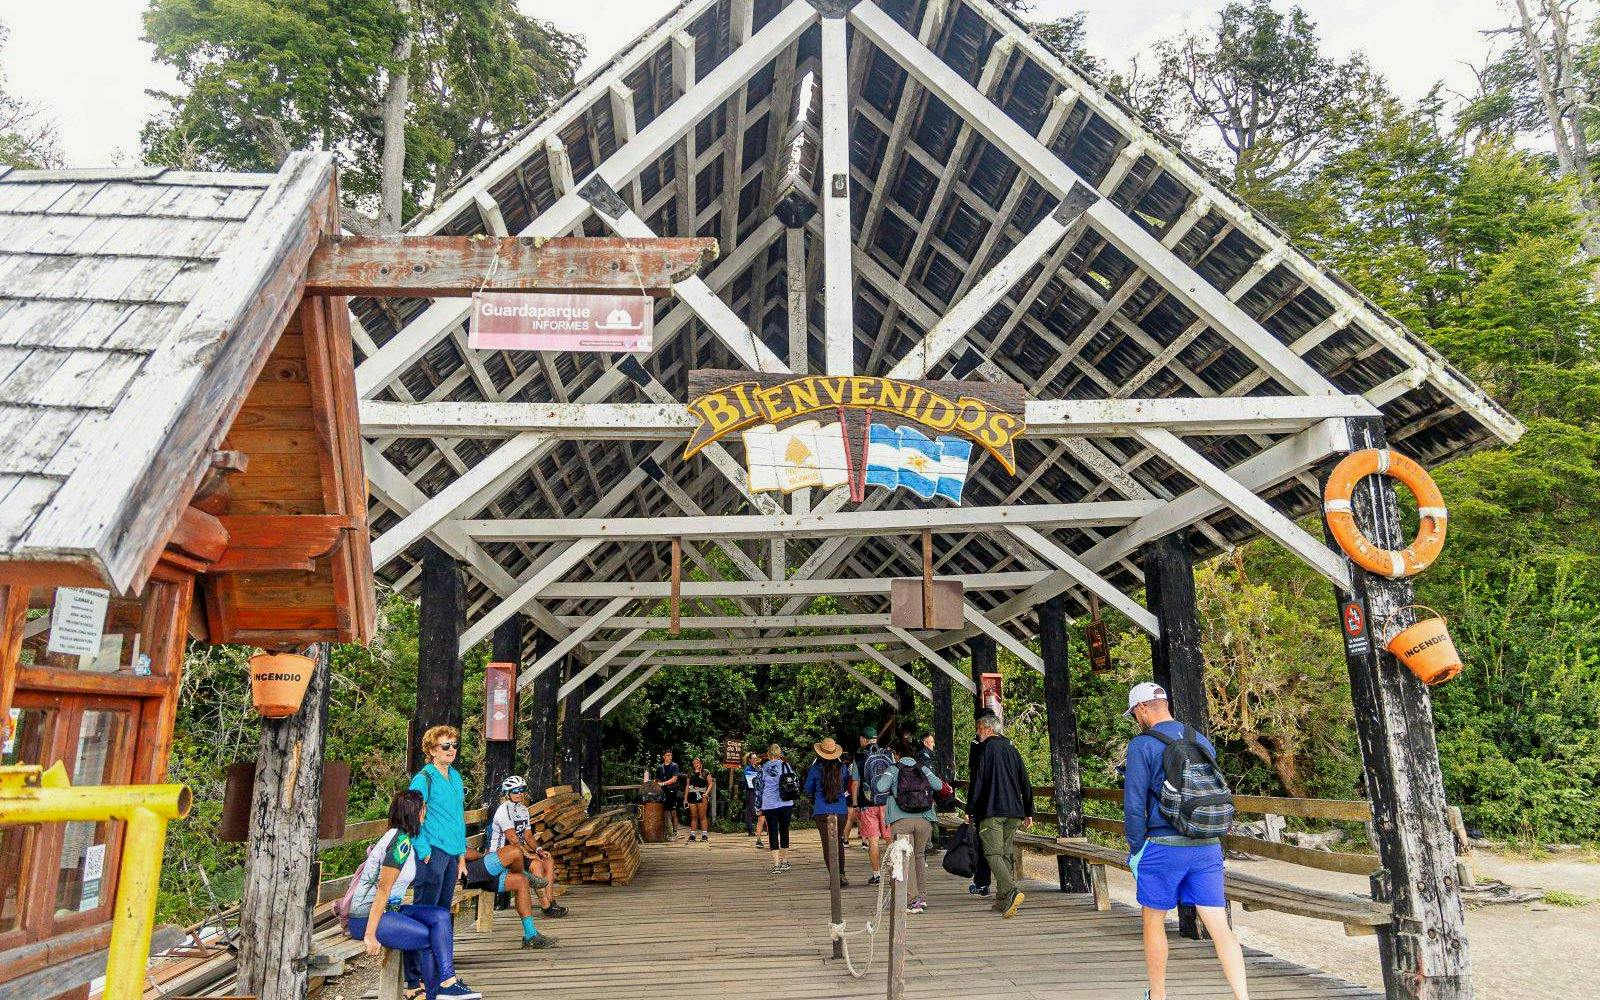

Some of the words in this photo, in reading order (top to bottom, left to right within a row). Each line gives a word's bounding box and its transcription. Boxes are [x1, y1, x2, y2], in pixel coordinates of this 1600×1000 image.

[481, 303, 591, 320] Guardaparque
[532, 320, 590, 331] INFORMES
[696, 378, 1016, 449] BIENVENIDOS
[1403, 634, 1447, 659] INCENDIO
[254, 673, 301, 682] INCENDIO
